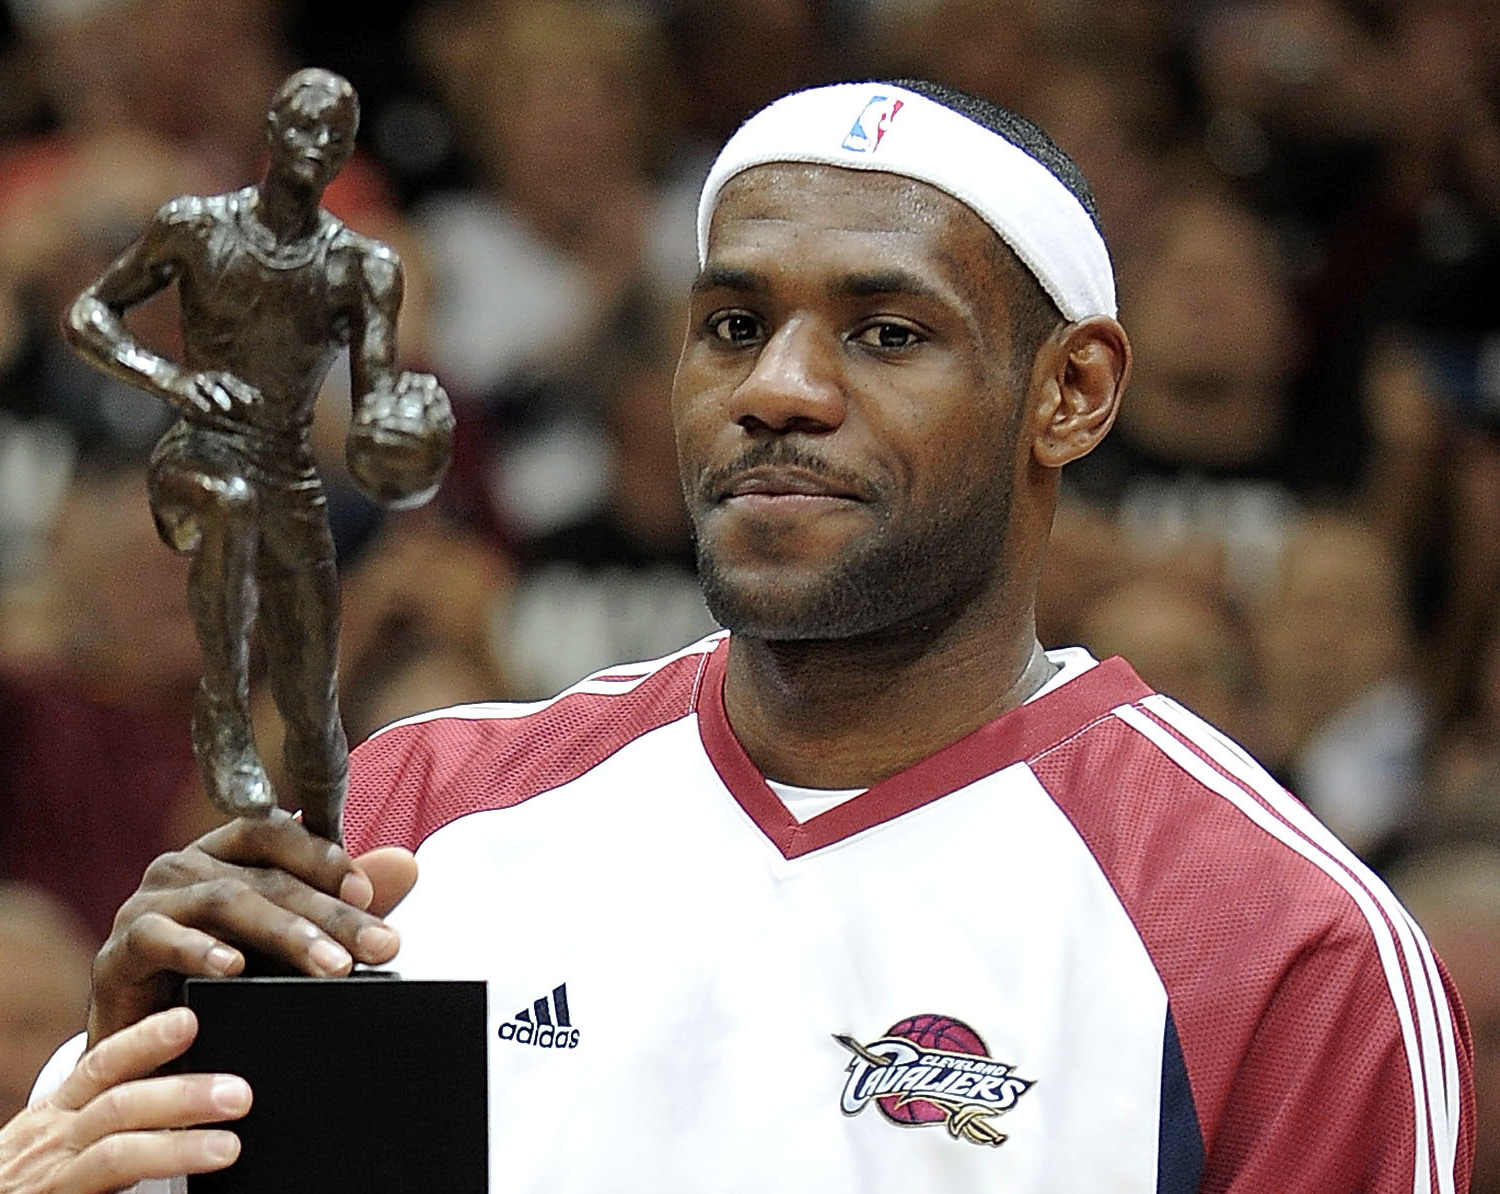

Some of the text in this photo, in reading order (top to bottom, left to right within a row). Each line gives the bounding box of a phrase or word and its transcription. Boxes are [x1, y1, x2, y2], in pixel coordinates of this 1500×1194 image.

[498, 1022, 580, 1049] adidas
[840, 1040, 1028, 1114] CAVALIERS
[919, 1055, 1008, 1077] CLEVELAND
